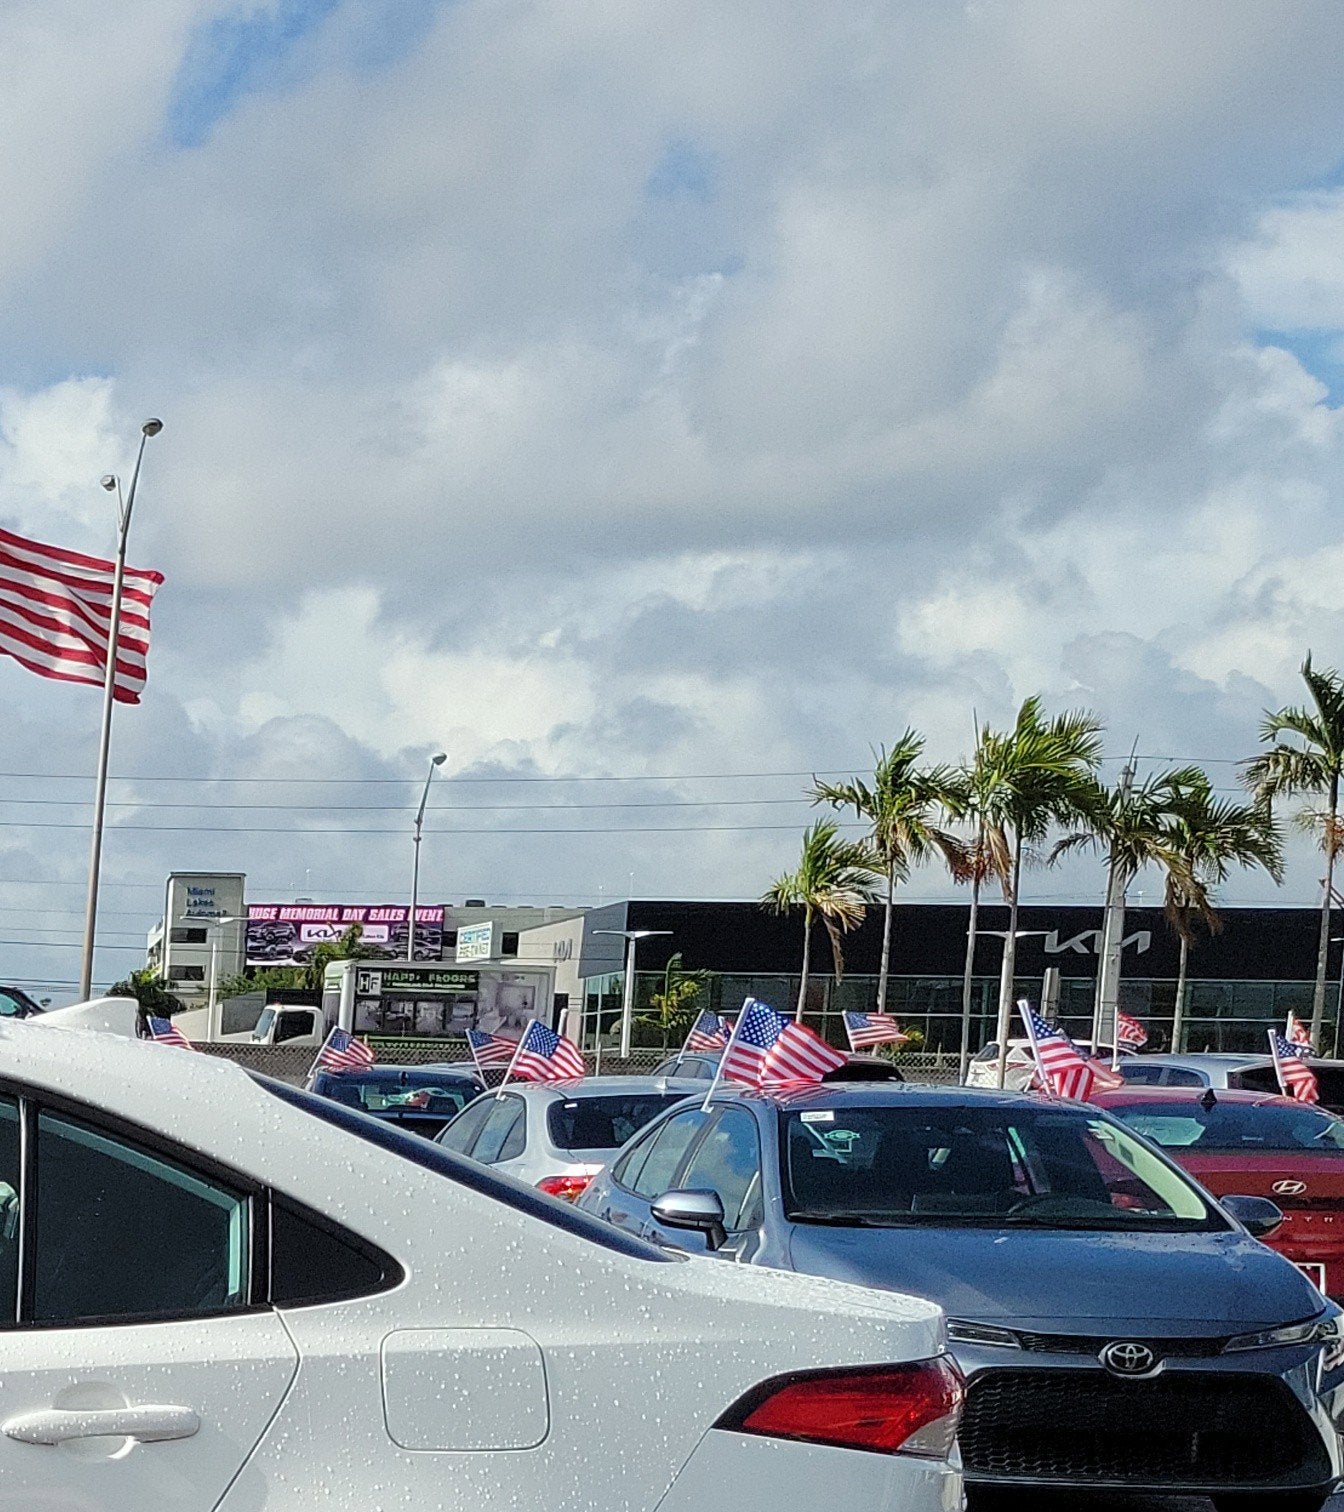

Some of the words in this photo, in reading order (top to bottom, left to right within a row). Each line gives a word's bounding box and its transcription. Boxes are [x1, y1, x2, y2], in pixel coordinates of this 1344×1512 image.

[279, 907, 339, 921] MEMORIAL
[342, 908, 366, 921] DAY
[369, 909, 405, 921] SALES
